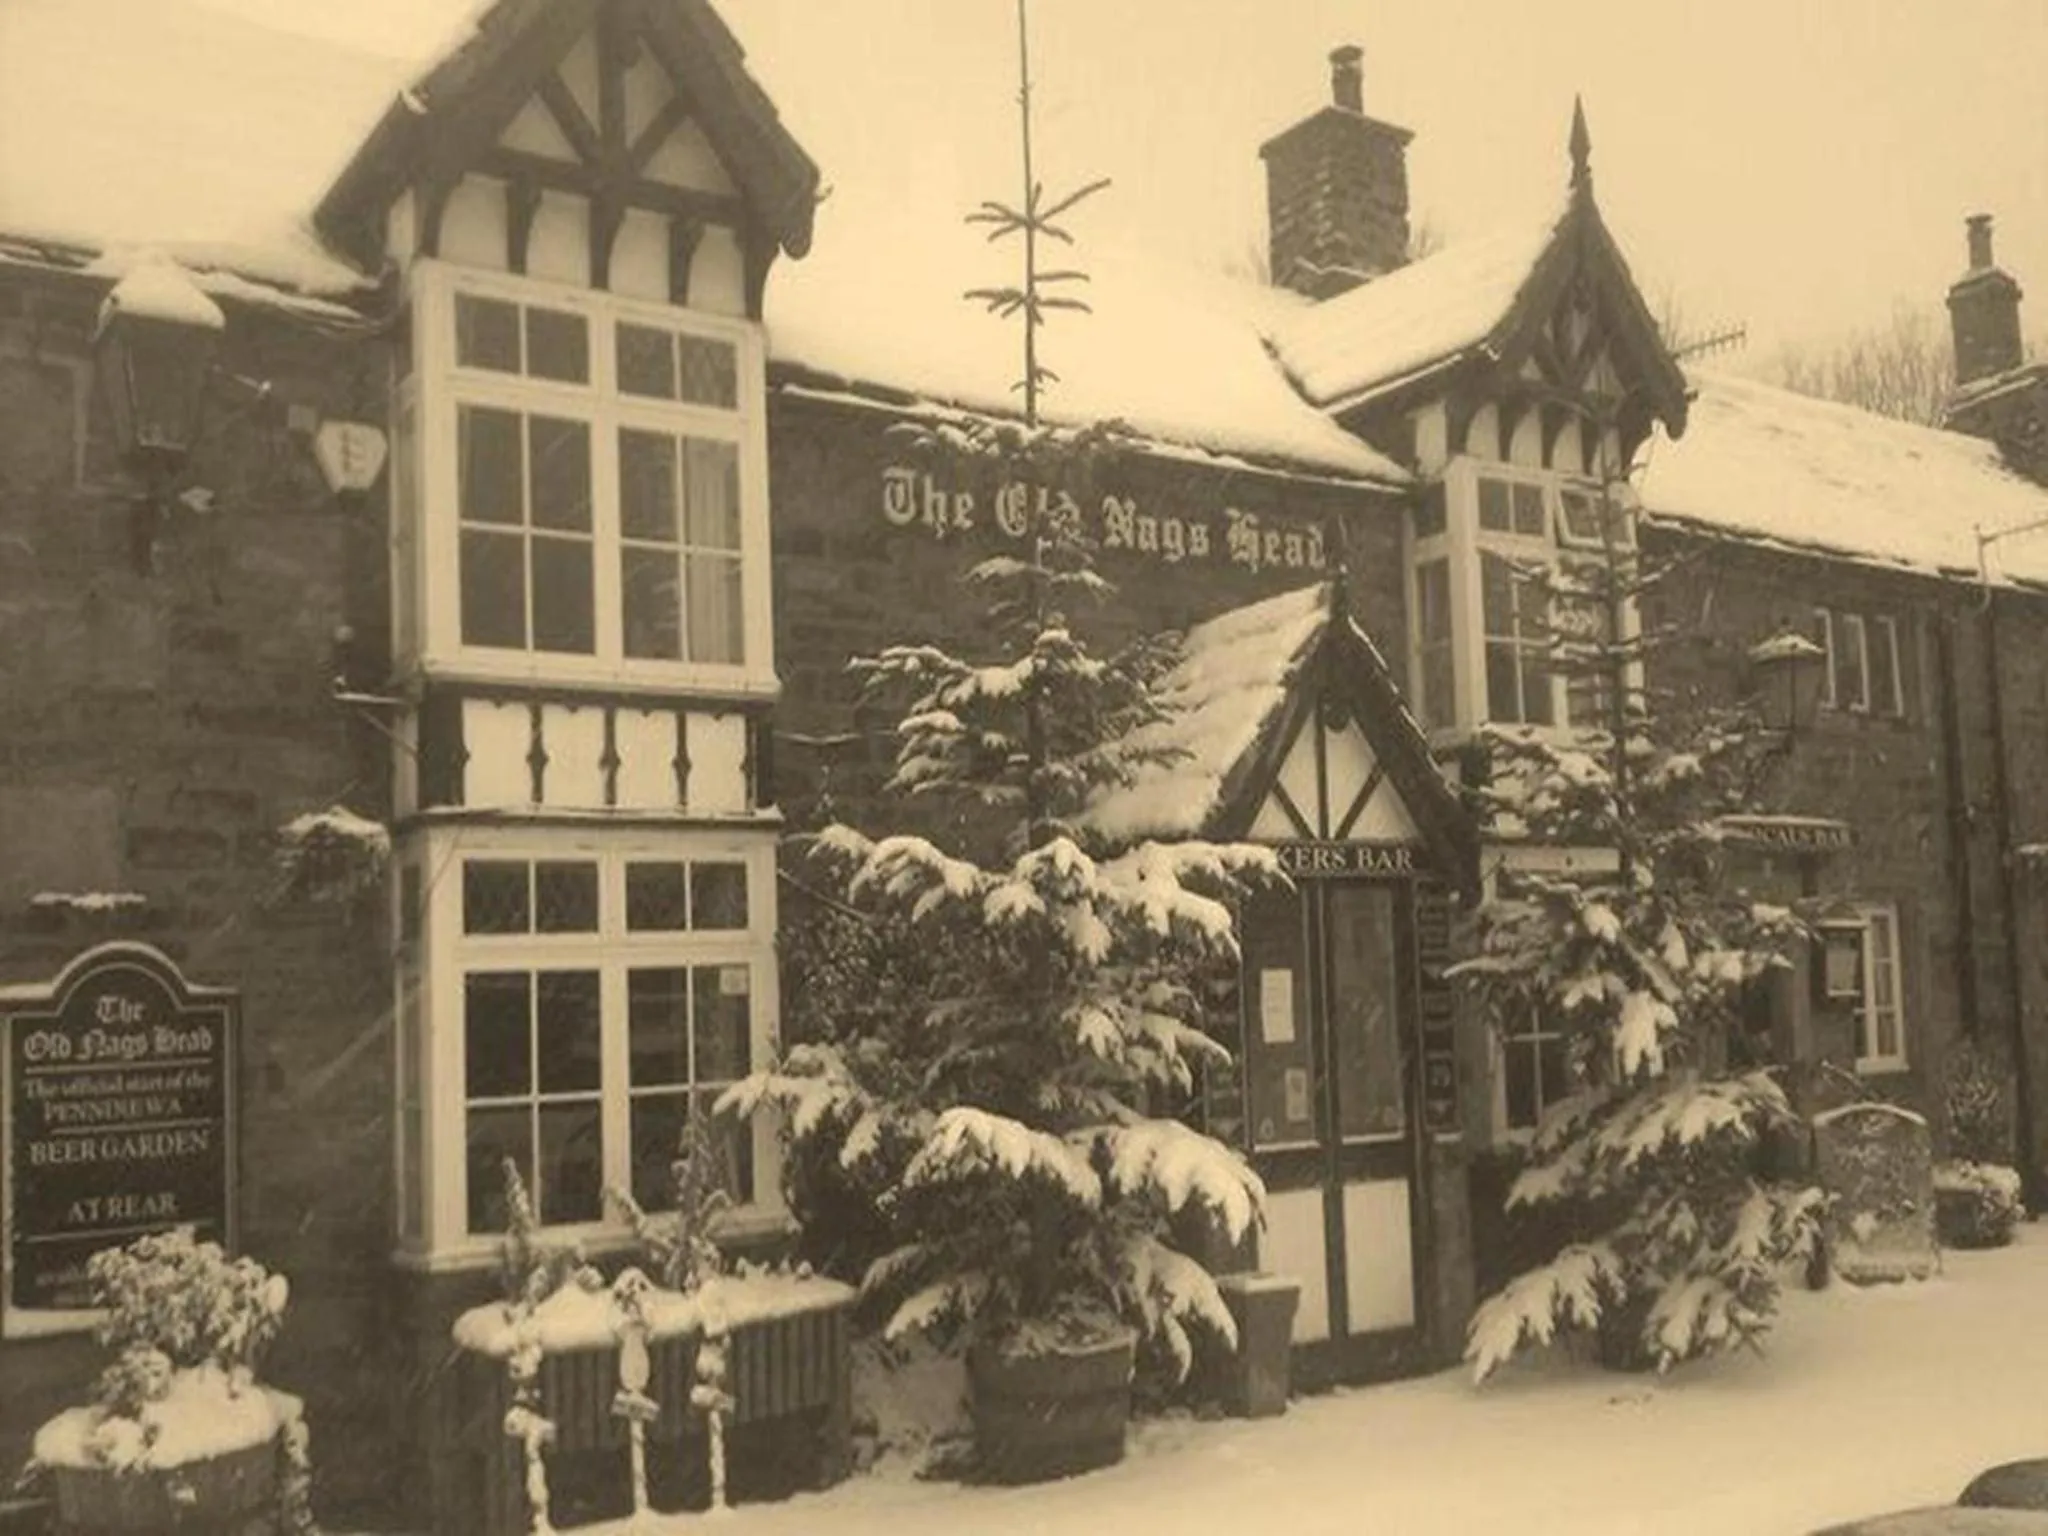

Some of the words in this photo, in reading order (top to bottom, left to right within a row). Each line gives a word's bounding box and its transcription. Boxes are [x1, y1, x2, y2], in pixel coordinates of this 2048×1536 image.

[882, 466, 975, 540] The
[1102, 495, 1210, 563] Nags
[1224, 507, 1326, 573] Head
[1276, 847, 1347, 871] KERS
[1357, 847, 1413, 871] BAR
[96, 995, 146, 1024] The
[24, 1030, 72, 1062] Old
[75, 1027, 149, 1060] Nags
[153, 1024, 213, 1054] Head
[22, 1077, 57, 1099] The
[29, 1137, 96, 1166] BEER
[101, 1127, 211, 1160] GARDEN
[68, 1196, 102, 1225] AT
[107, 1191, 179, 1221] REAR
